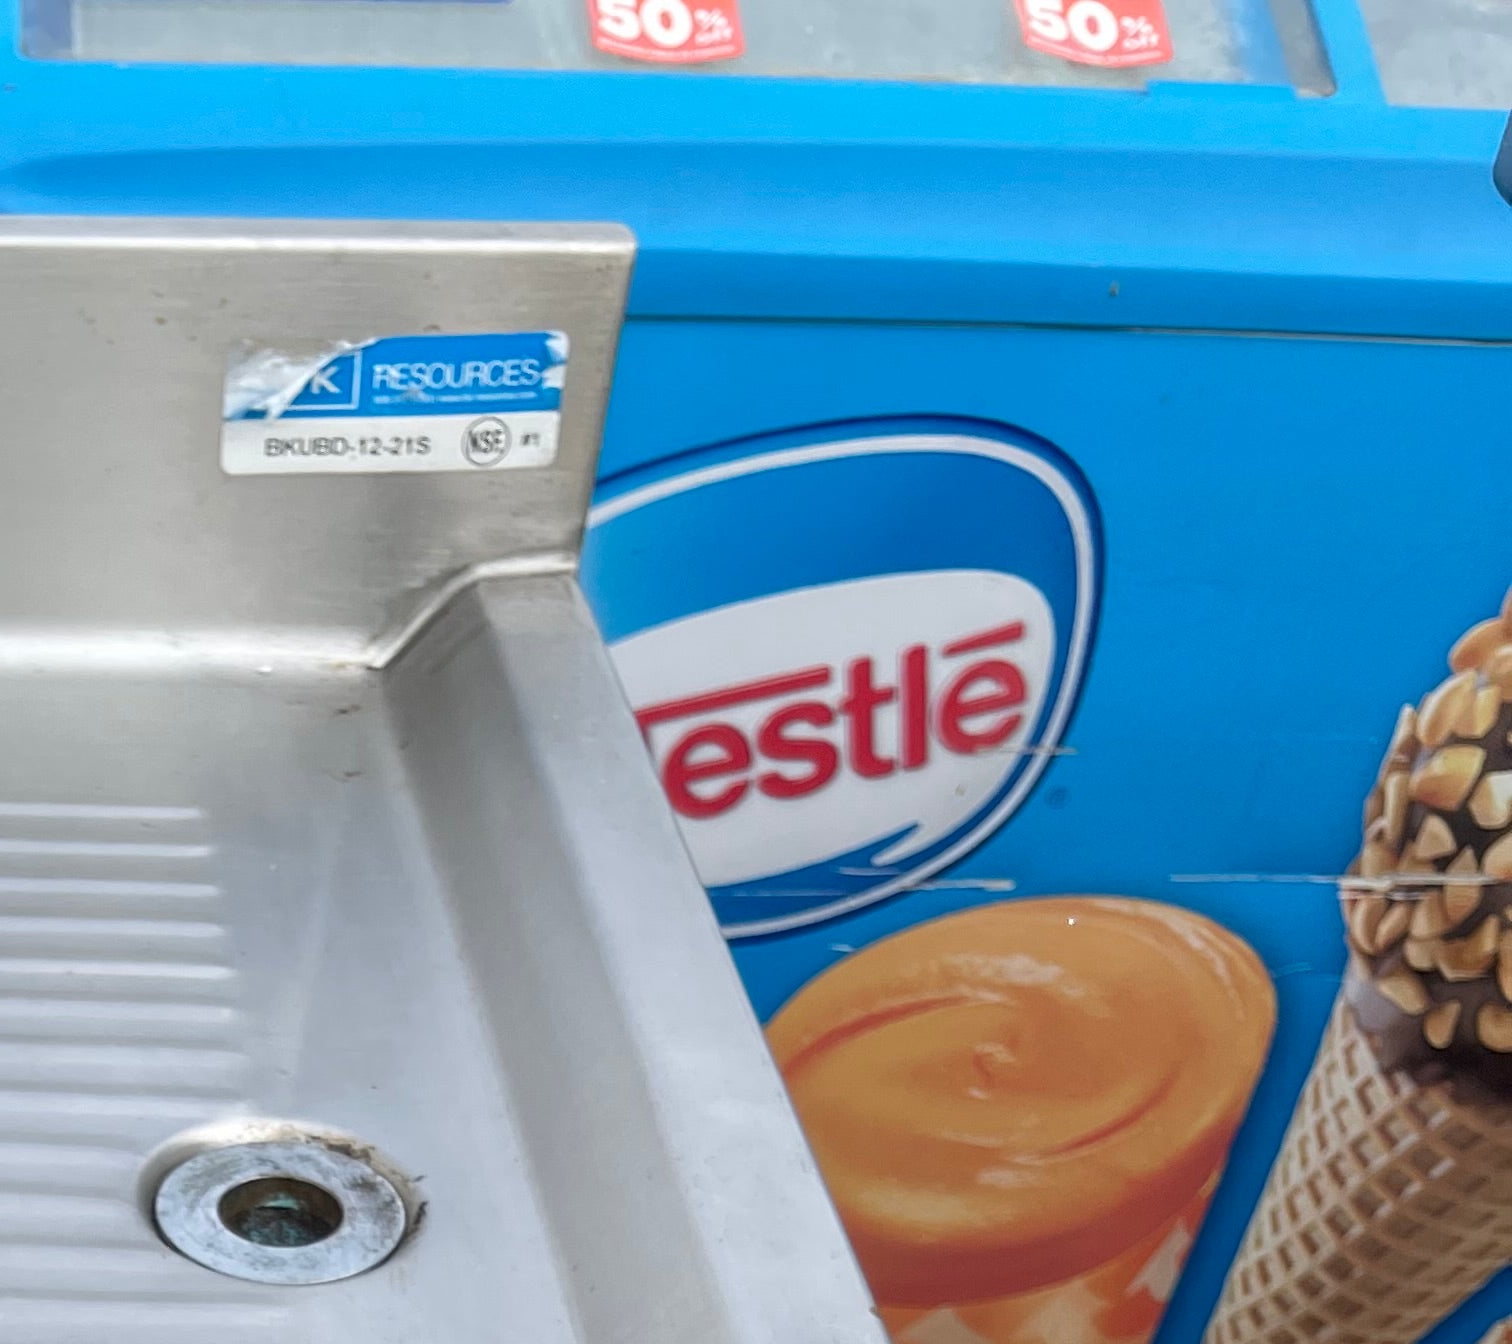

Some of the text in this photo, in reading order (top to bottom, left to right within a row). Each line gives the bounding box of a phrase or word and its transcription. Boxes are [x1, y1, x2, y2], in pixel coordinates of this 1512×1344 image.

[310, 359, 540, 395] K RESOURCES
[634, 620, 1026, 820] estlé
